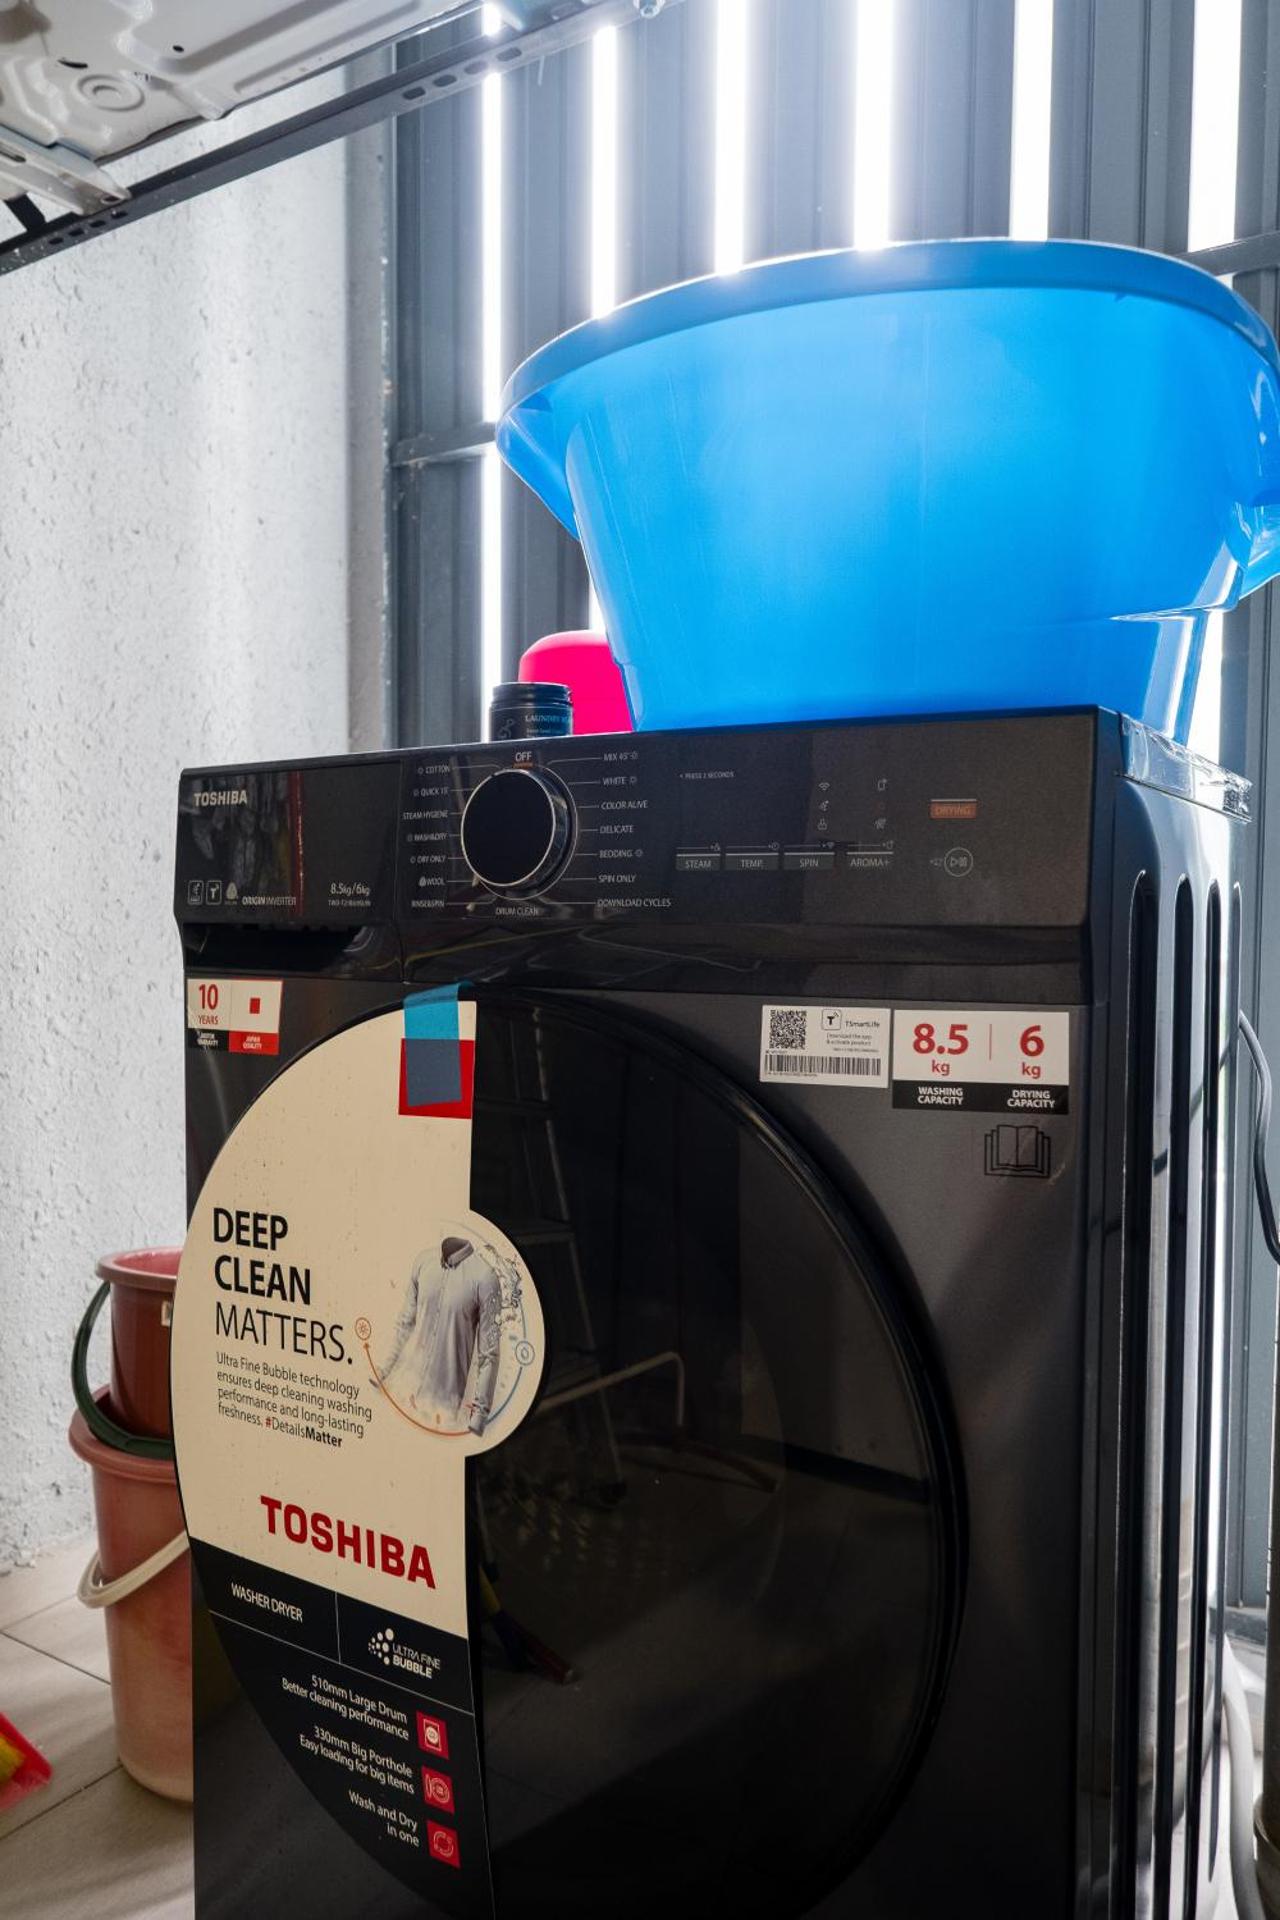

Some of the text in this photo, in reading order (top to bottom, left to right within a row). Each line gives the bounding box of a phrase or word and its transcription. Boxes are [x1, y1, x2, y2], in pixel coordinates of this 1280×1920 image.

[515, 751, 532, 762] OFF
[603, 753, 617, 761] MIX
[426, 765, 450, 774] COTTON
[602, 777, 627, 786] WHITE
[194, 790, 248, 807] TOSHIBA
[421, 787, 440, 797] QUICK
[601, 799, 648, 810] COLOR ALIVE
[935, 804, 971, 816] DRYING
[403, 810, 448, 820] STEAM HYGIENE
[600, 825, 634, 834] DELICATE
[417, 855, 446, 863] DRY ONLY
[600, 849, 632, 858] BEDDING
[685, 859, 712, 869] STEAM
[799, 858, 819, 868] SPIN
[850, 858, 890, 868] AROMA+
[427, 877, 445, 886] WOOL
[598, 873, 637, 883] SPIN ONLY
[597, 897, 672, 908] DOWNLOAD CYCLES
[495, 905, 539, 916] DRUM CLEAN
[198, 984, 219, 1010] 10
[198, 1015, 219, 1026] YEARS
[912, 1023, 969, 1055] 8.5
[1019, 1025, 1044, 1057] 6
[931, 1059, 951, 1076] kg
[1021, 1062, 1041, 1079] kg
[918, 1086, 963, 1097] WASHING
[1012, 1089, 1050, 1100] DRYING
[917, 1095, 964, 1106] CAPACITY
[1007, 1098, 1055, 1109] CAPACITY
[213, 1207, 289, 1251] DEEP
[214, 1254, 311, 1306] CLEAN
[215, 1301, 353, 1365] MATTERS.
[216, 1352, 360, 1400] Ultra Fine Bubble technology
[217, 1372, 372, 1422] ensures deep cleaning washing
[217, 1387, 364, 1439] performance and long-lasting
[265, 1416, 343, 1448] #DetailsMatter
[260, 1495, 436, 1590] TOSHIBA
[231, 1582, 303, 1623] WASHER DRYER
[392, 1643, 441, 1670] ULTRA FINE
[393, 1655, 433, 1679] BUBBLE
[311, 1674, 408, 1723] 510mm Large Drum
[282, 1677, 409, 1741] Better cleaning performance
[314, 1725, 413, 1778] 330mm Big Porthole
[300, 1734, 415, 1795] Easy loading for big items
[349, 1789, 418, 1833] Wash and Dry
[387, 1822, 420, 1848] in one
